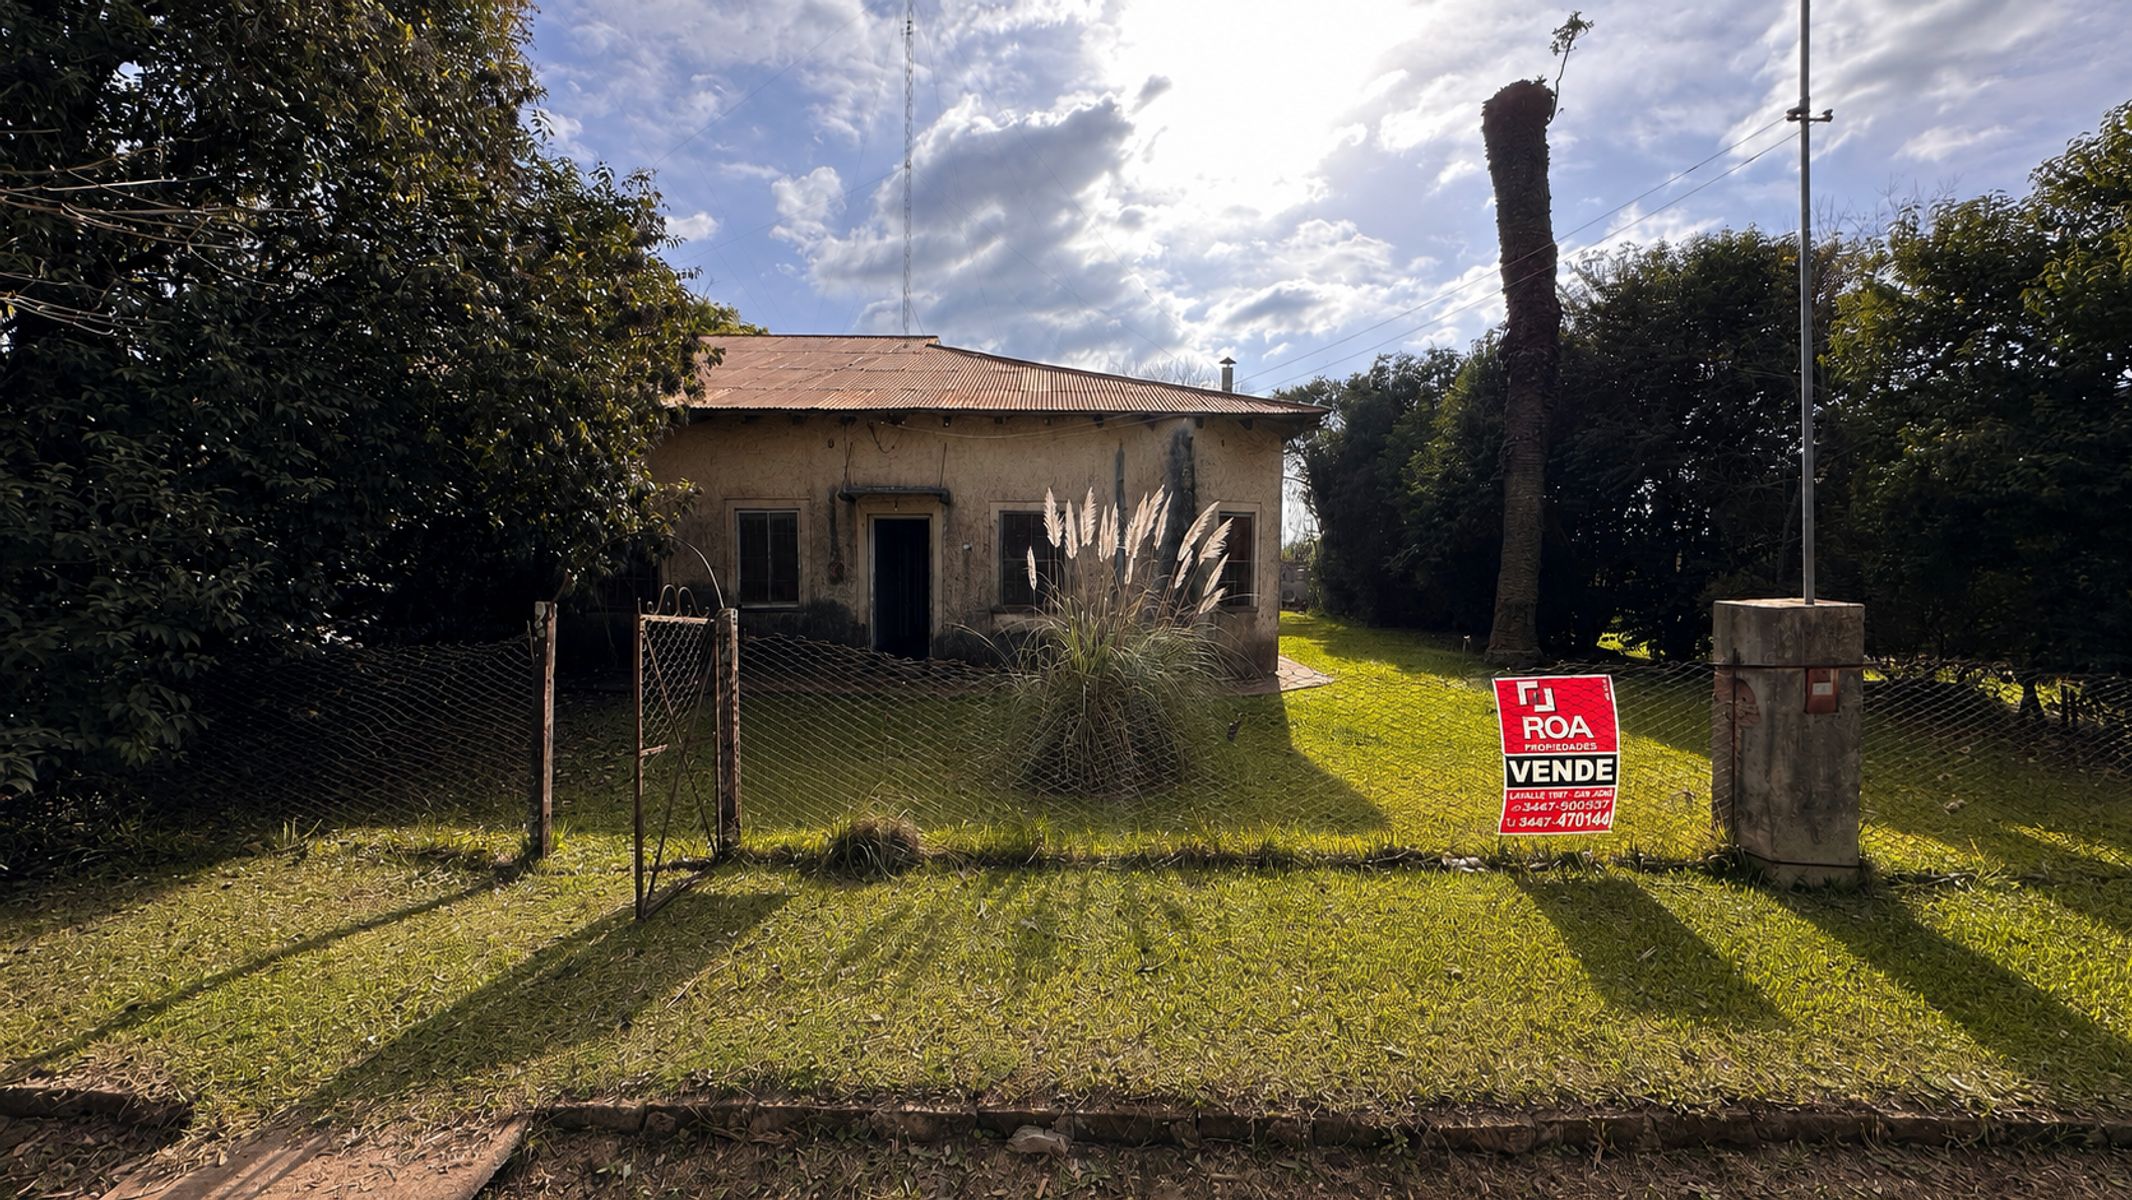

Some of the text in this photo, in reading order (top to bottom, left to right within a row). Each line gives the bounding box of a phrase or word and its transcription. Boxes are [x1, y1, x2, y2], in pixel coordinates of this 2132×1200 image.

[1522, 715, 1595, 740] ROA
[1524, 743, 1598, 752] PROPIEDADES
[1508, 758, 1613, 783] VENDE
